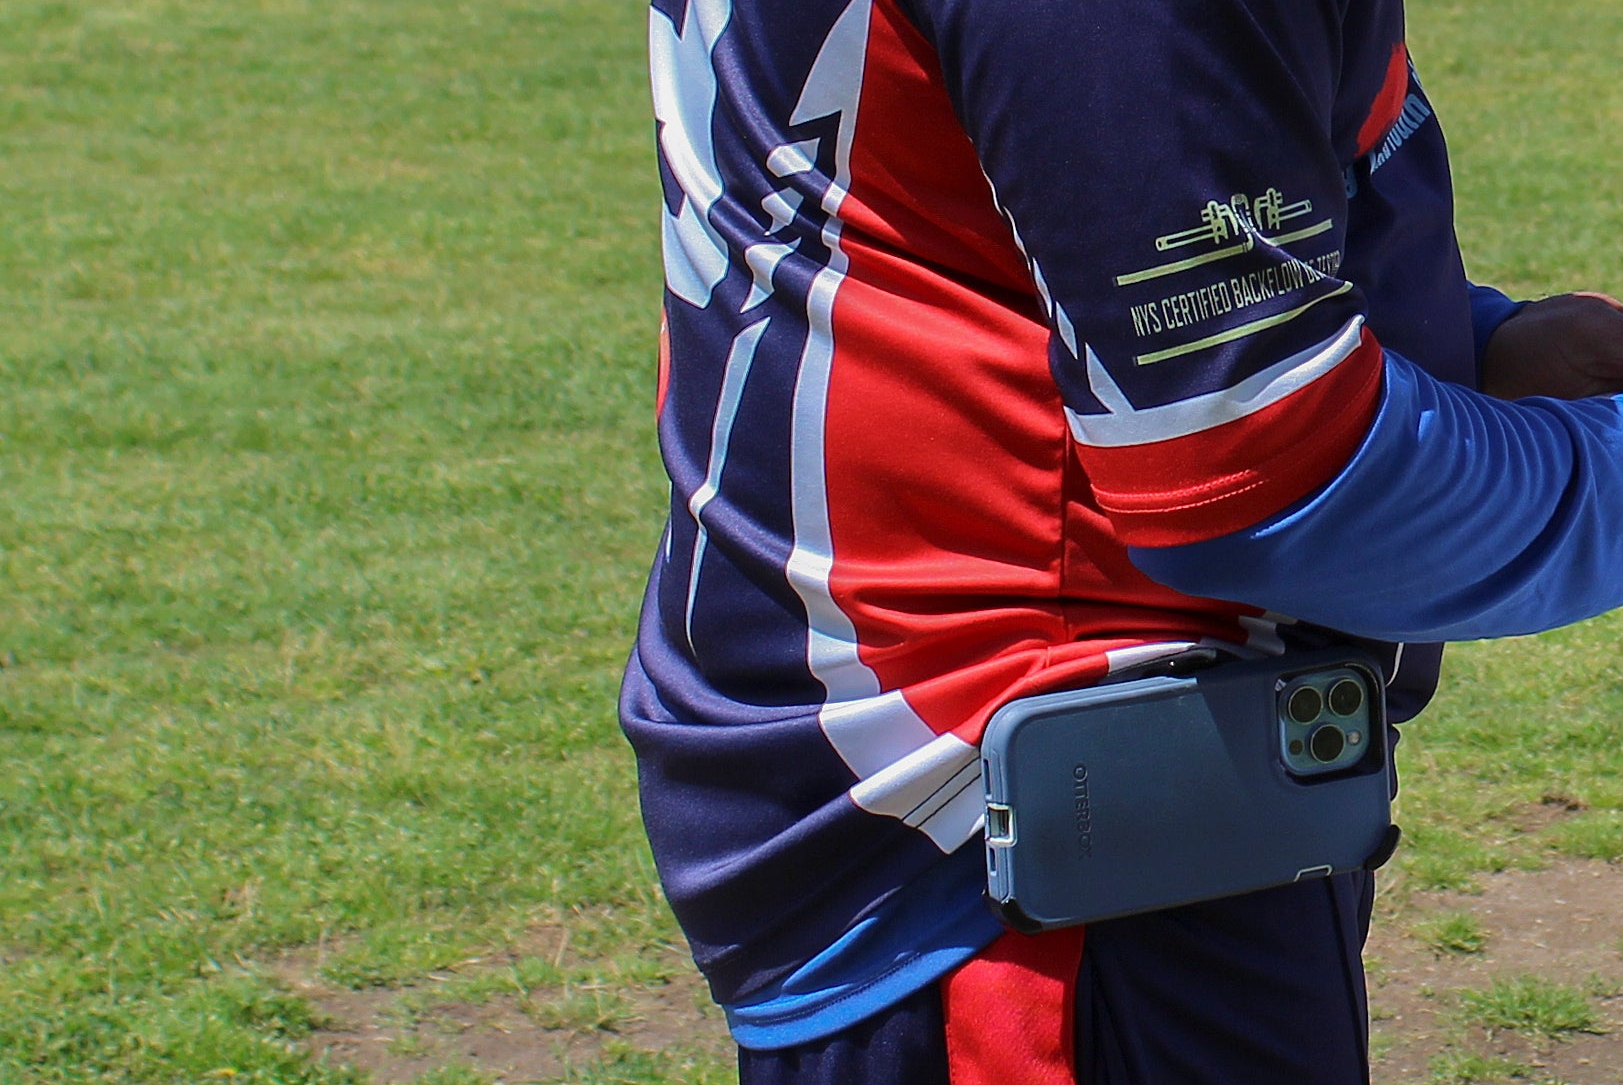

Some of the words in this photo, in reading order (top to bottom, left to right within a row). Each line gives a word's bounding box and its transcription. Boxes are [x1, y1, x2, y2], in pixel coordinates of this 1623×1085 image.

[1130, 302, 1162, 337] NYS
[1161, 281, 1232, 330] CERTIFIED
[1230, 258, 1304, 309] BACKFLOW
[1073, 762, 1092, 861] OTTERBOX
